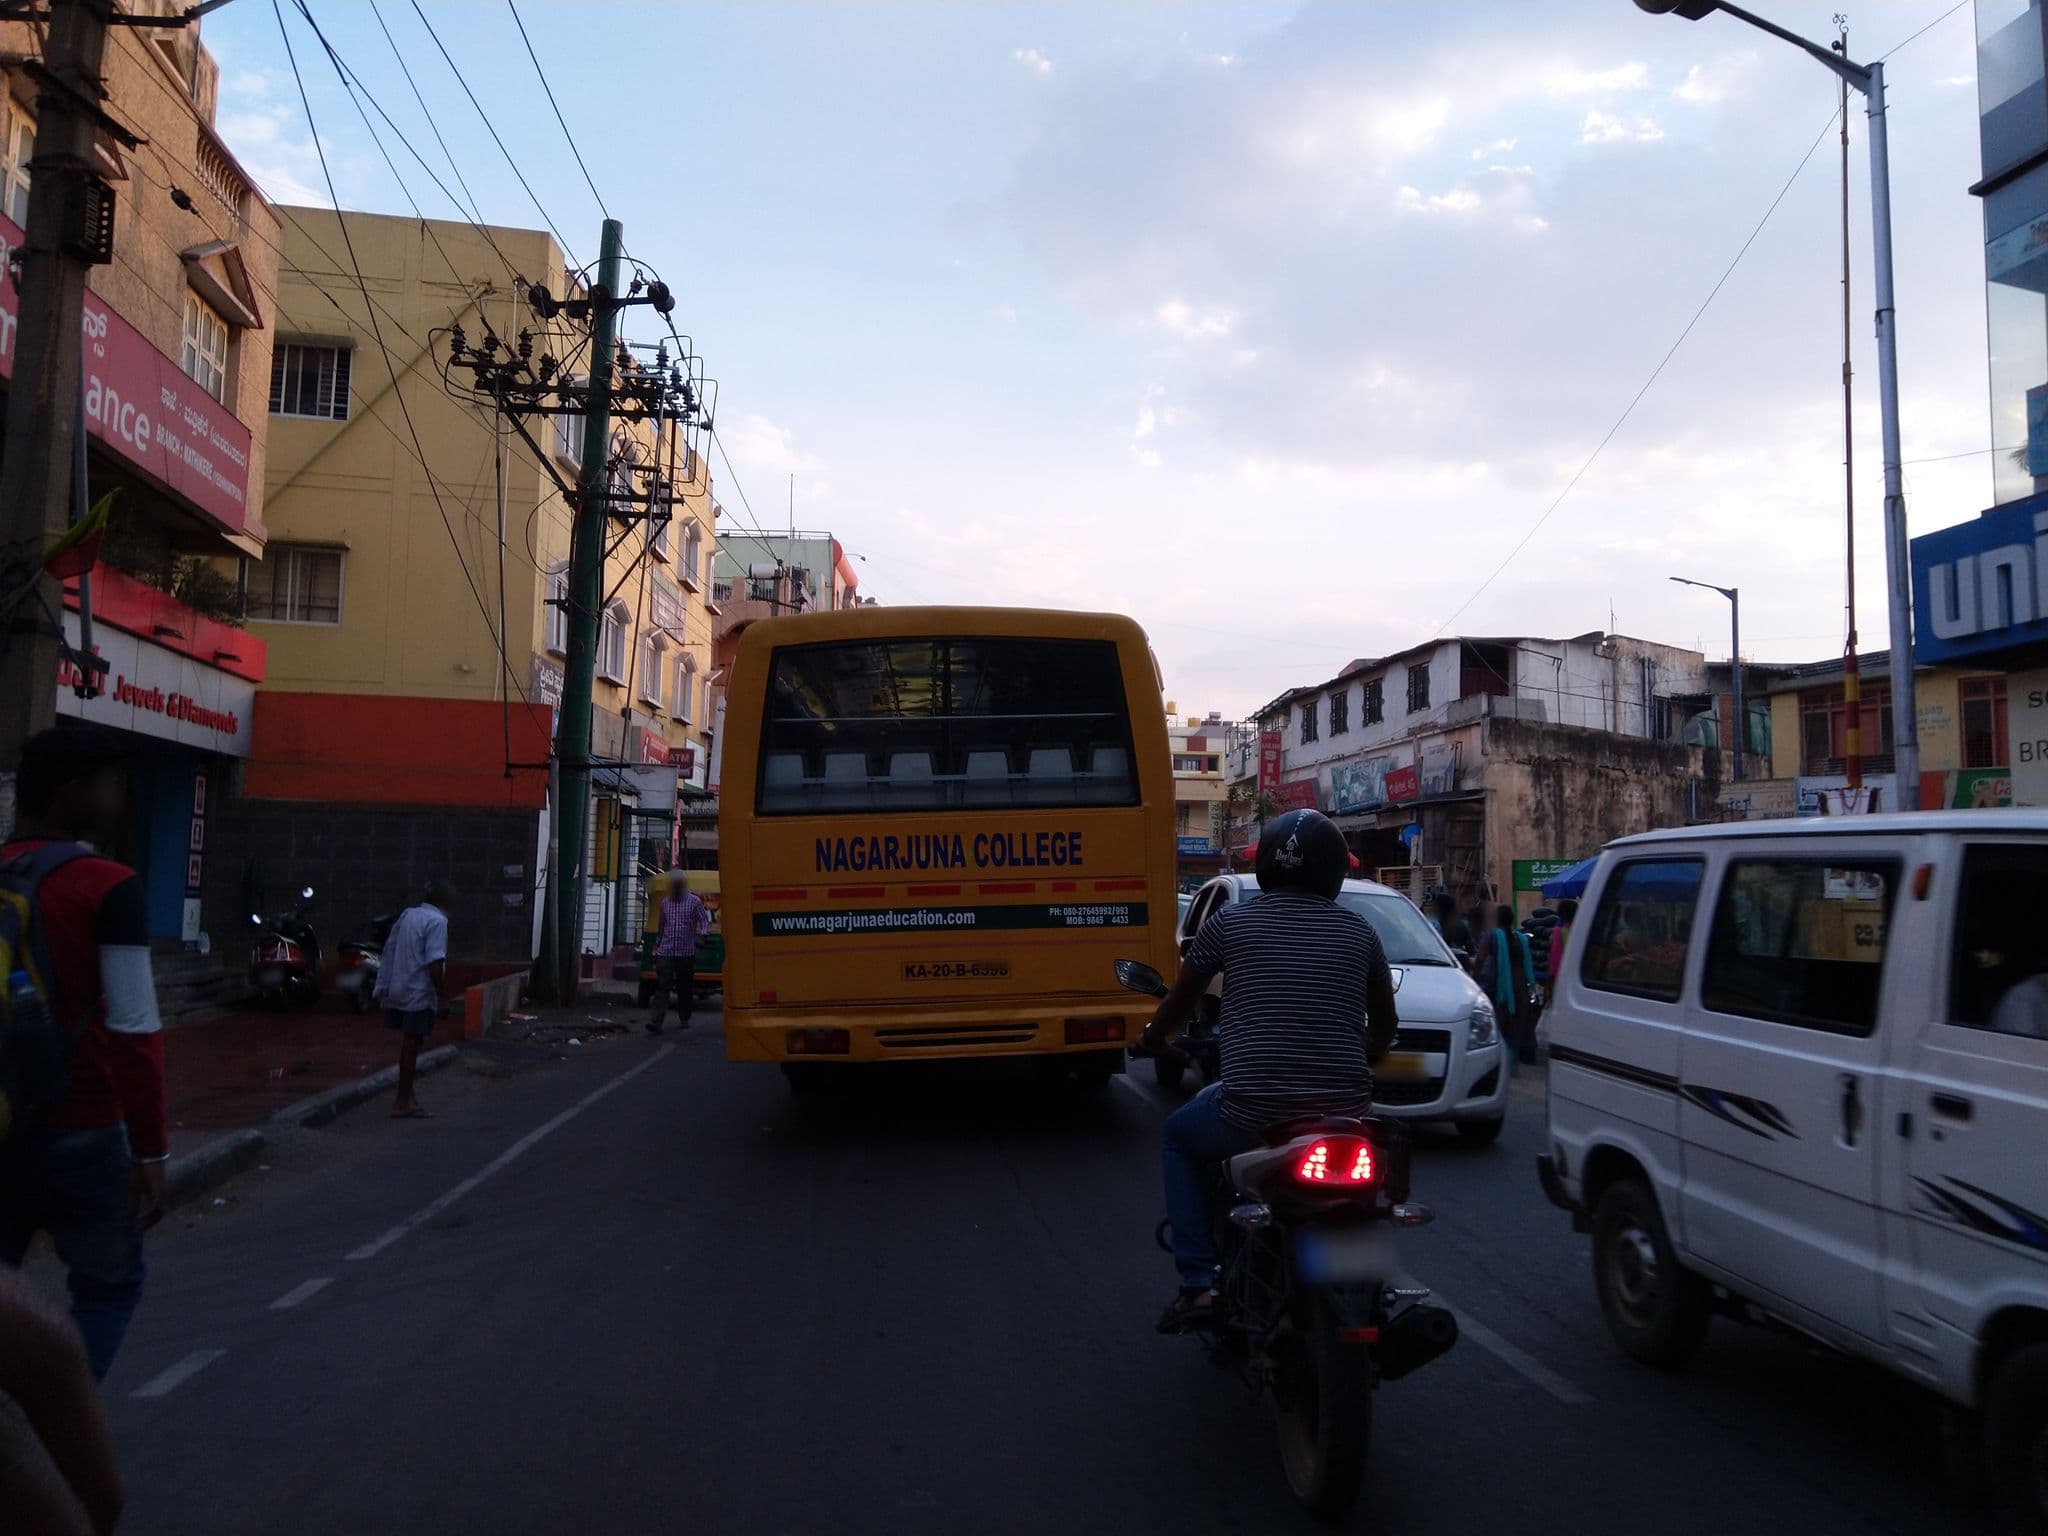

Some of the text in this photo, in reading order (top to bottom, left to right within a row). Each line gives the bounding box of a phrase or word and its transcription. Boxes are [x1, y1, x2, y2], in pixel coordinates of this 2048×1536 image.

[113, 674, 164, 713] Jewels
[178, 695, 238, 735] Diamonds
[670, 753, 690, 764] ATM
[815, 832, 1083, 873] NAGARJUNA COLLEGE
[1048, 907, 1062, 916] PH:
[1066, 915, 1129, 925] MOB: 9845 4433
[771, 910, 976, 933] www.nagarjunaeducation.com
